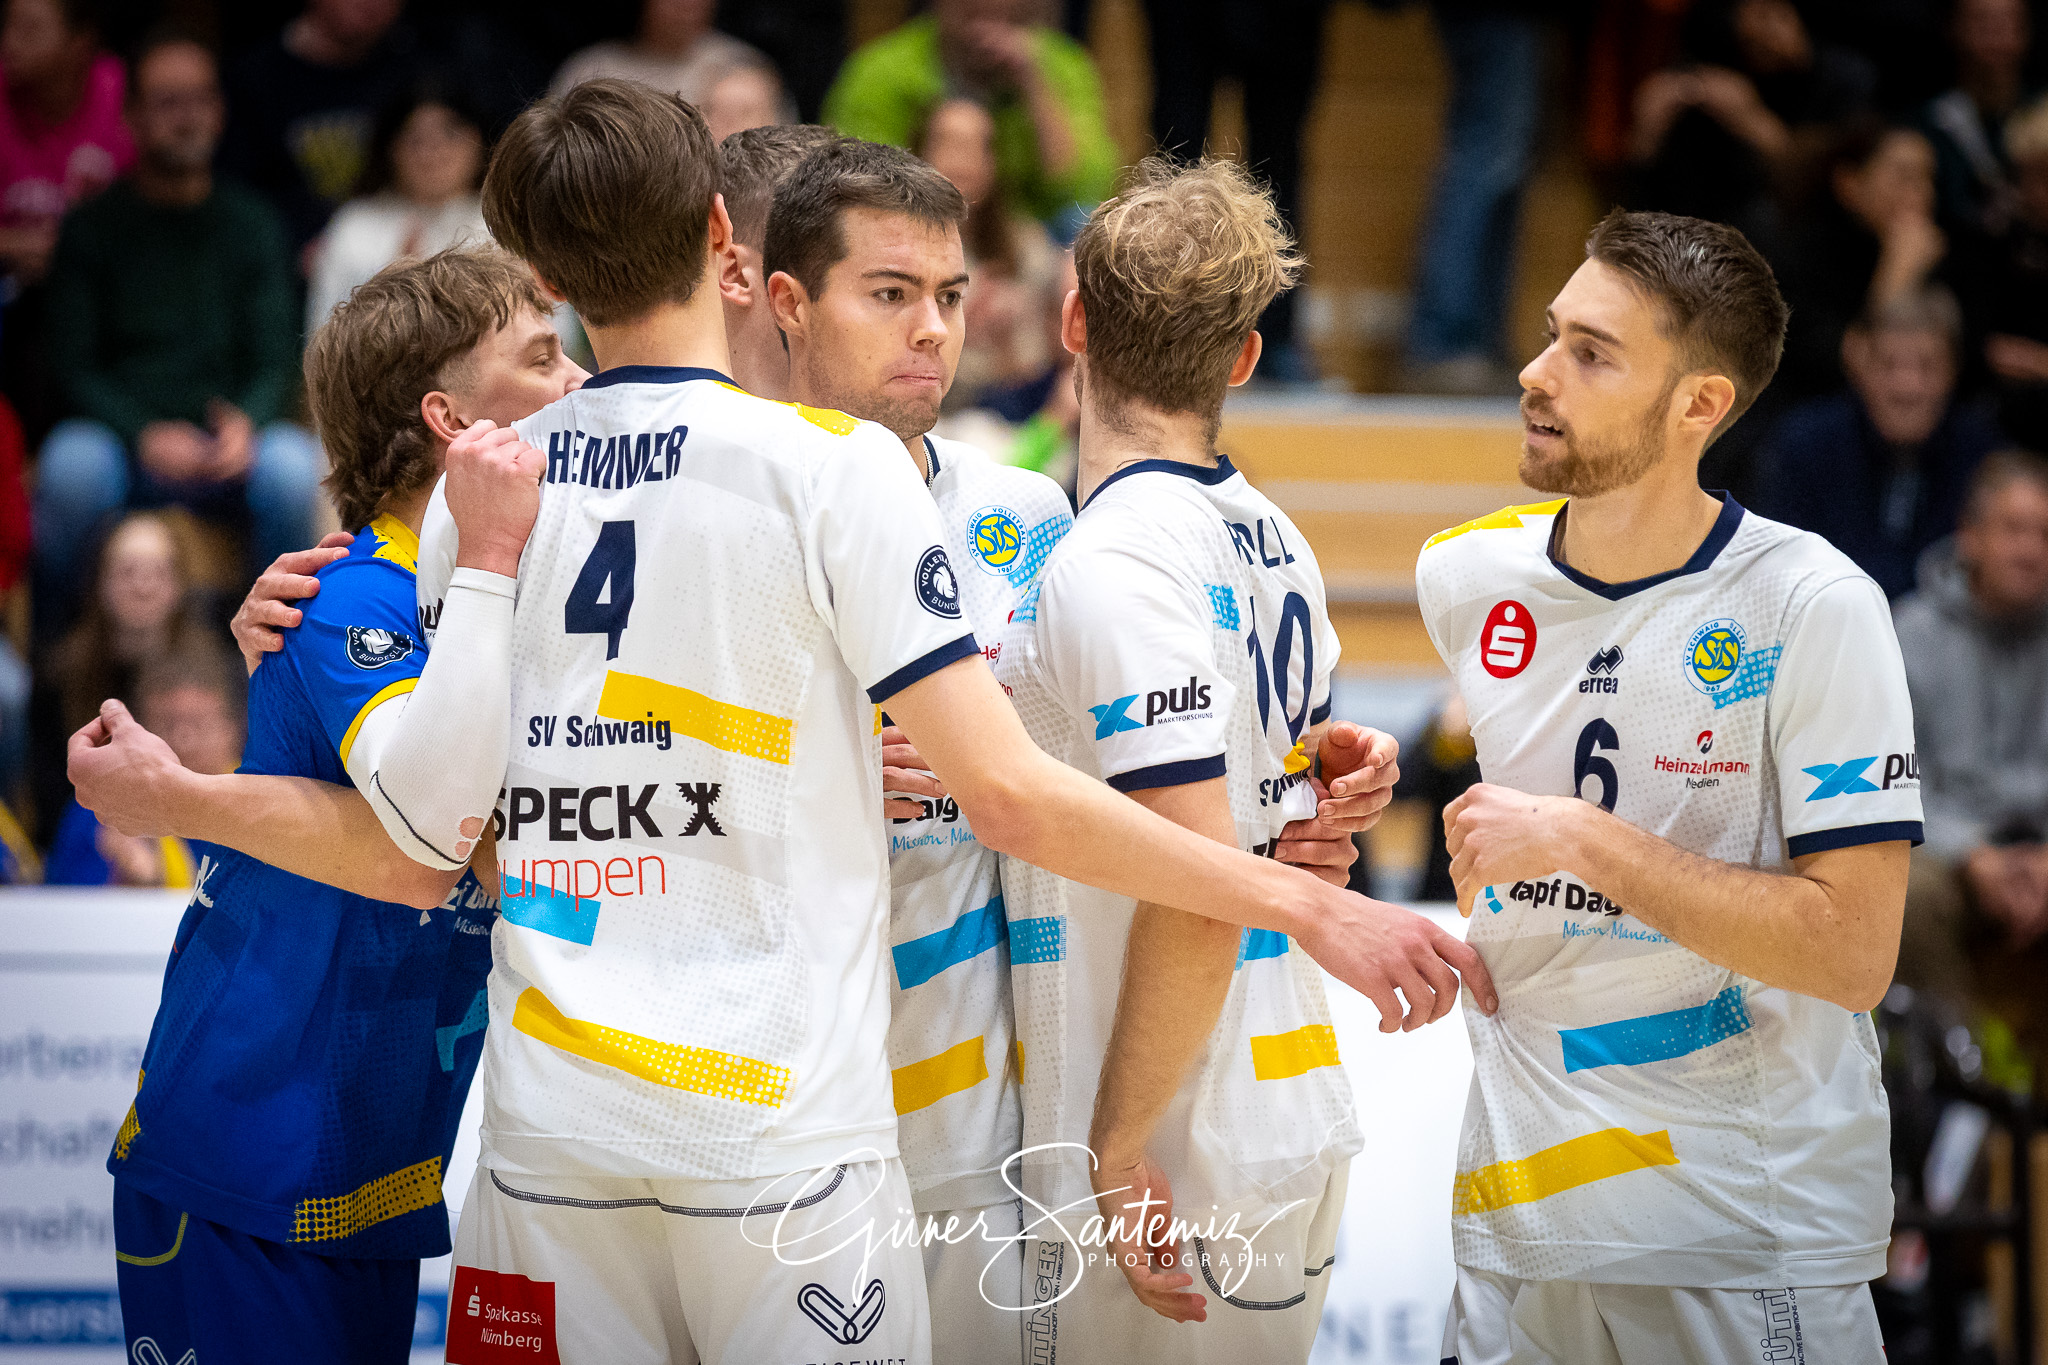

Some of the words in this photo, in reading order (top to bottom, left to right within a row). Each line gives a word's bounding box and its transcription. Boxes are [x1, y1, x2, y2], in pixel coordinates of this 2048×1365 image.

[546, 425, 688, 490] HEMMER
[565, 520, 636, 661] 4
[1247, 591, 1313, 746] 10
[1146, 676, 1211, 726] puls
[1157, 713, 1213, 724] MARKTFORSCHUNG
[528, 716, 557, 747] SV
[566, 711, 672, 751] Schwaig
[1573, 718, 1620, 814] 6
[1654, 755, 1749, 775] Heinzelmann
[495, 783, 664, 842] SPECK
[498, 856, 665, 912] umpen
[481, 1327, 542, 1352] Nürnberg
